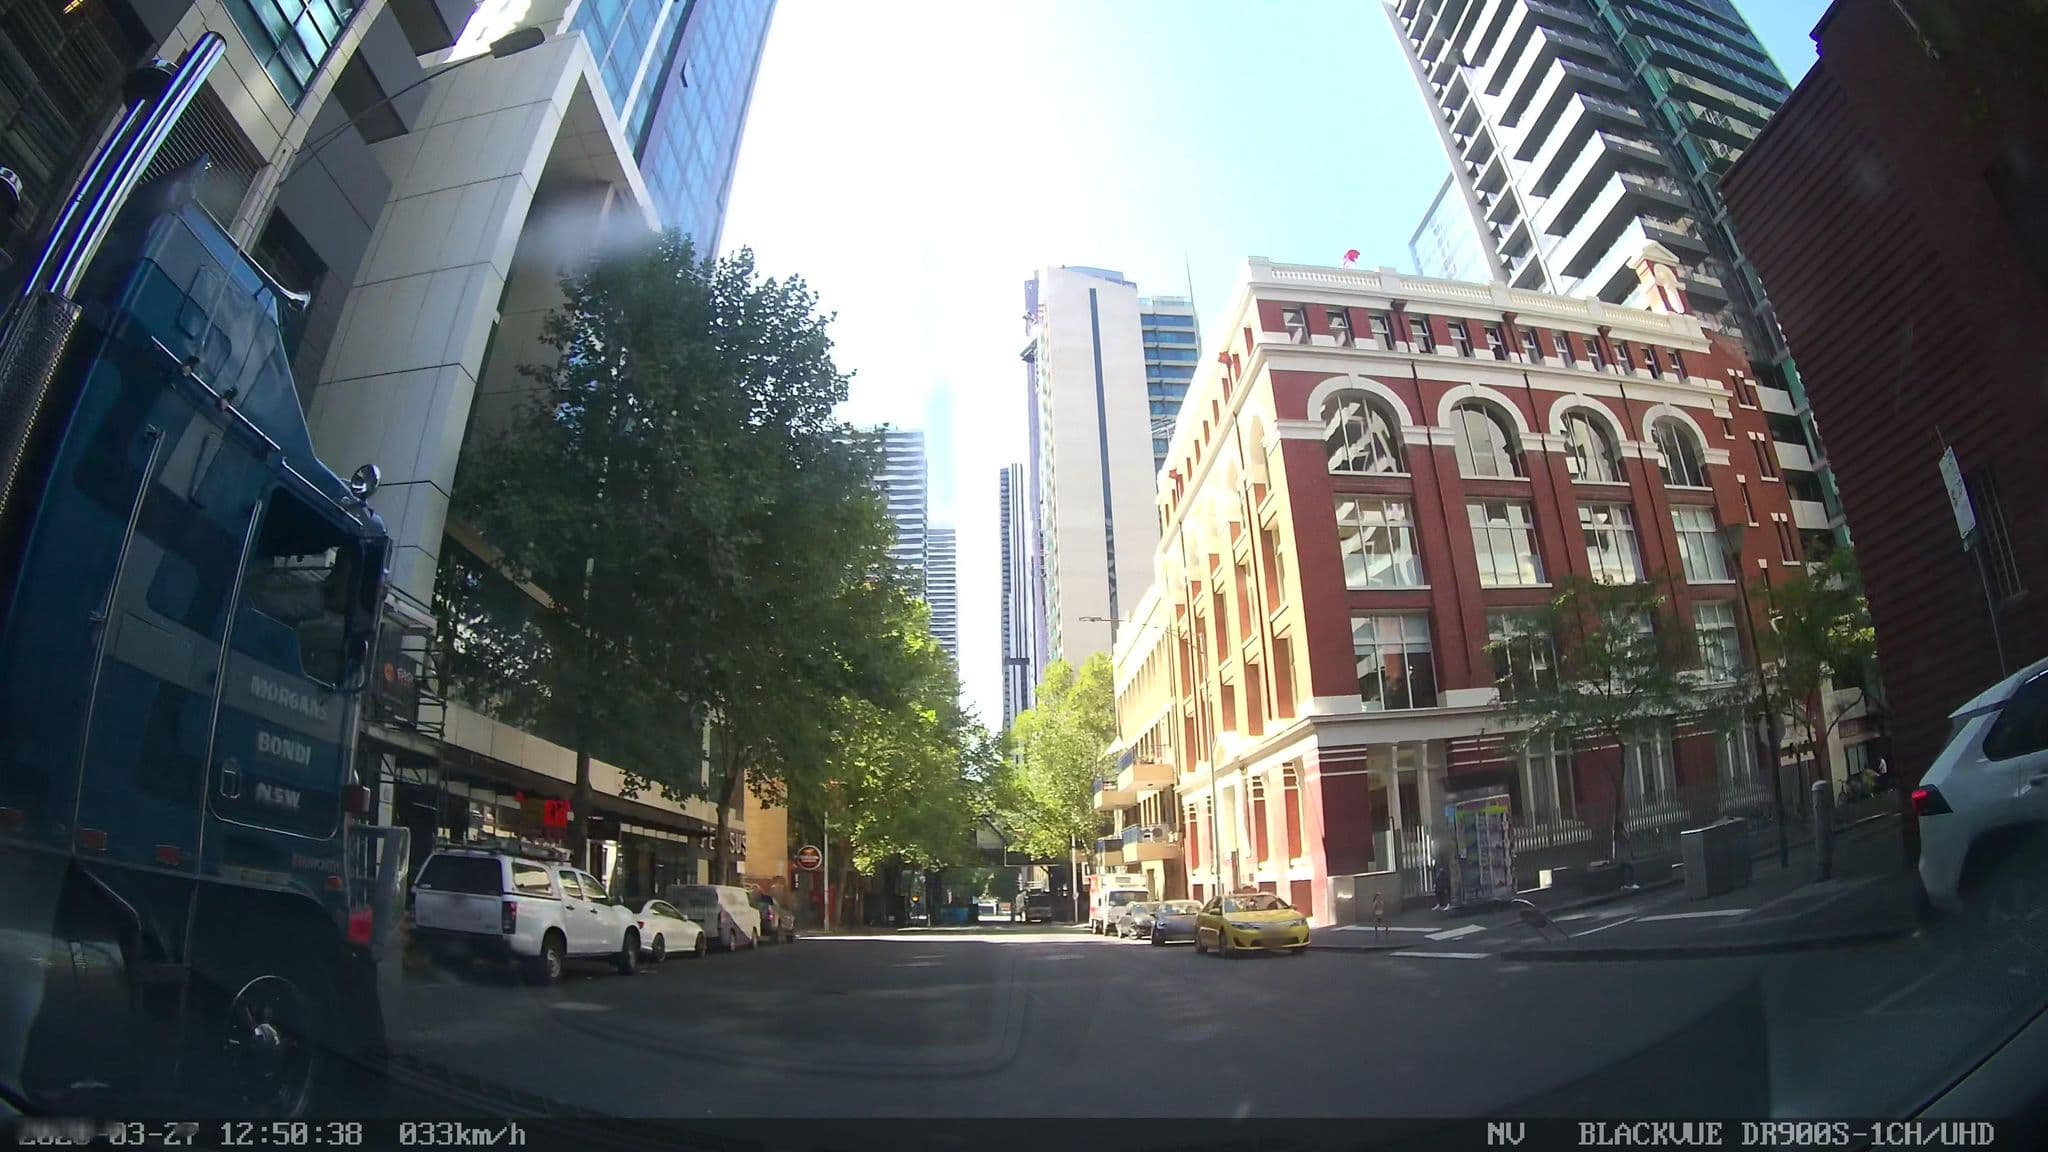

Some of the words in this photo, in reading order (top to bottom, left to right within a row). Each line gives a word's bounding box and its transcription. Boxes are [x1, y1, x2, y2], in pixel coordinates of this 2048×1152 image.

[251, 675, 329, 720] MORGANS
[257, 731, 312, 766] BONDI
[256, 782, 301, 809] NSW
